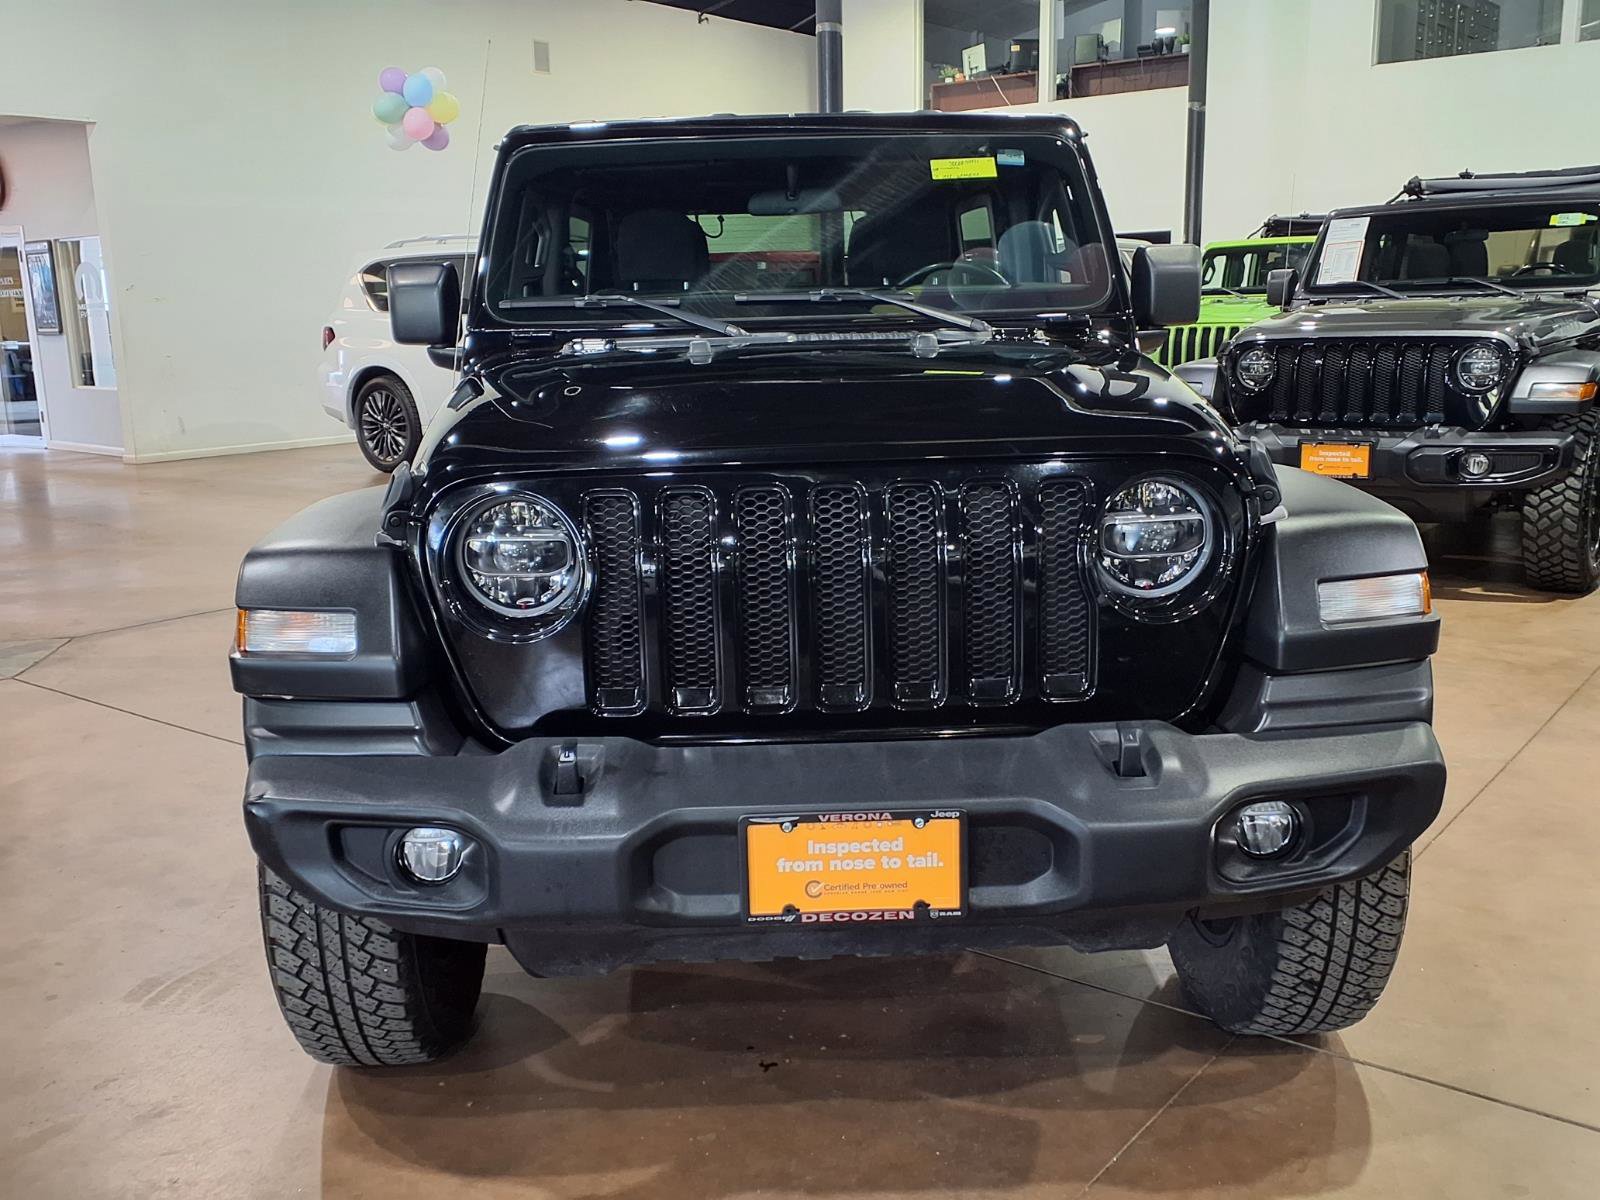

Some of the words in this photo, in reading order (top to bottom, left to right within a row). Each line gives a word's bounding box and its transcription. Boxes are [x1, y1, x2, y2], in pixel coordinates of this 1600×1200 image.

[818, 812, 893, 822] VERONA
[930, 810, 960, 819] Jeep
[807, 837, 904, 857] Inspected
[776, 857, 823, 873] from
[829, 857, 876, 872] nose
[880, 855, 902, 870] to
[906, 852, 944, 868] tail.
[824, 882, 860, 891] Certified
[862, 882, 877, 890] Pre
[880, 881, 908, 890] owned
[801, 910, 915, 923] DECOZEN
